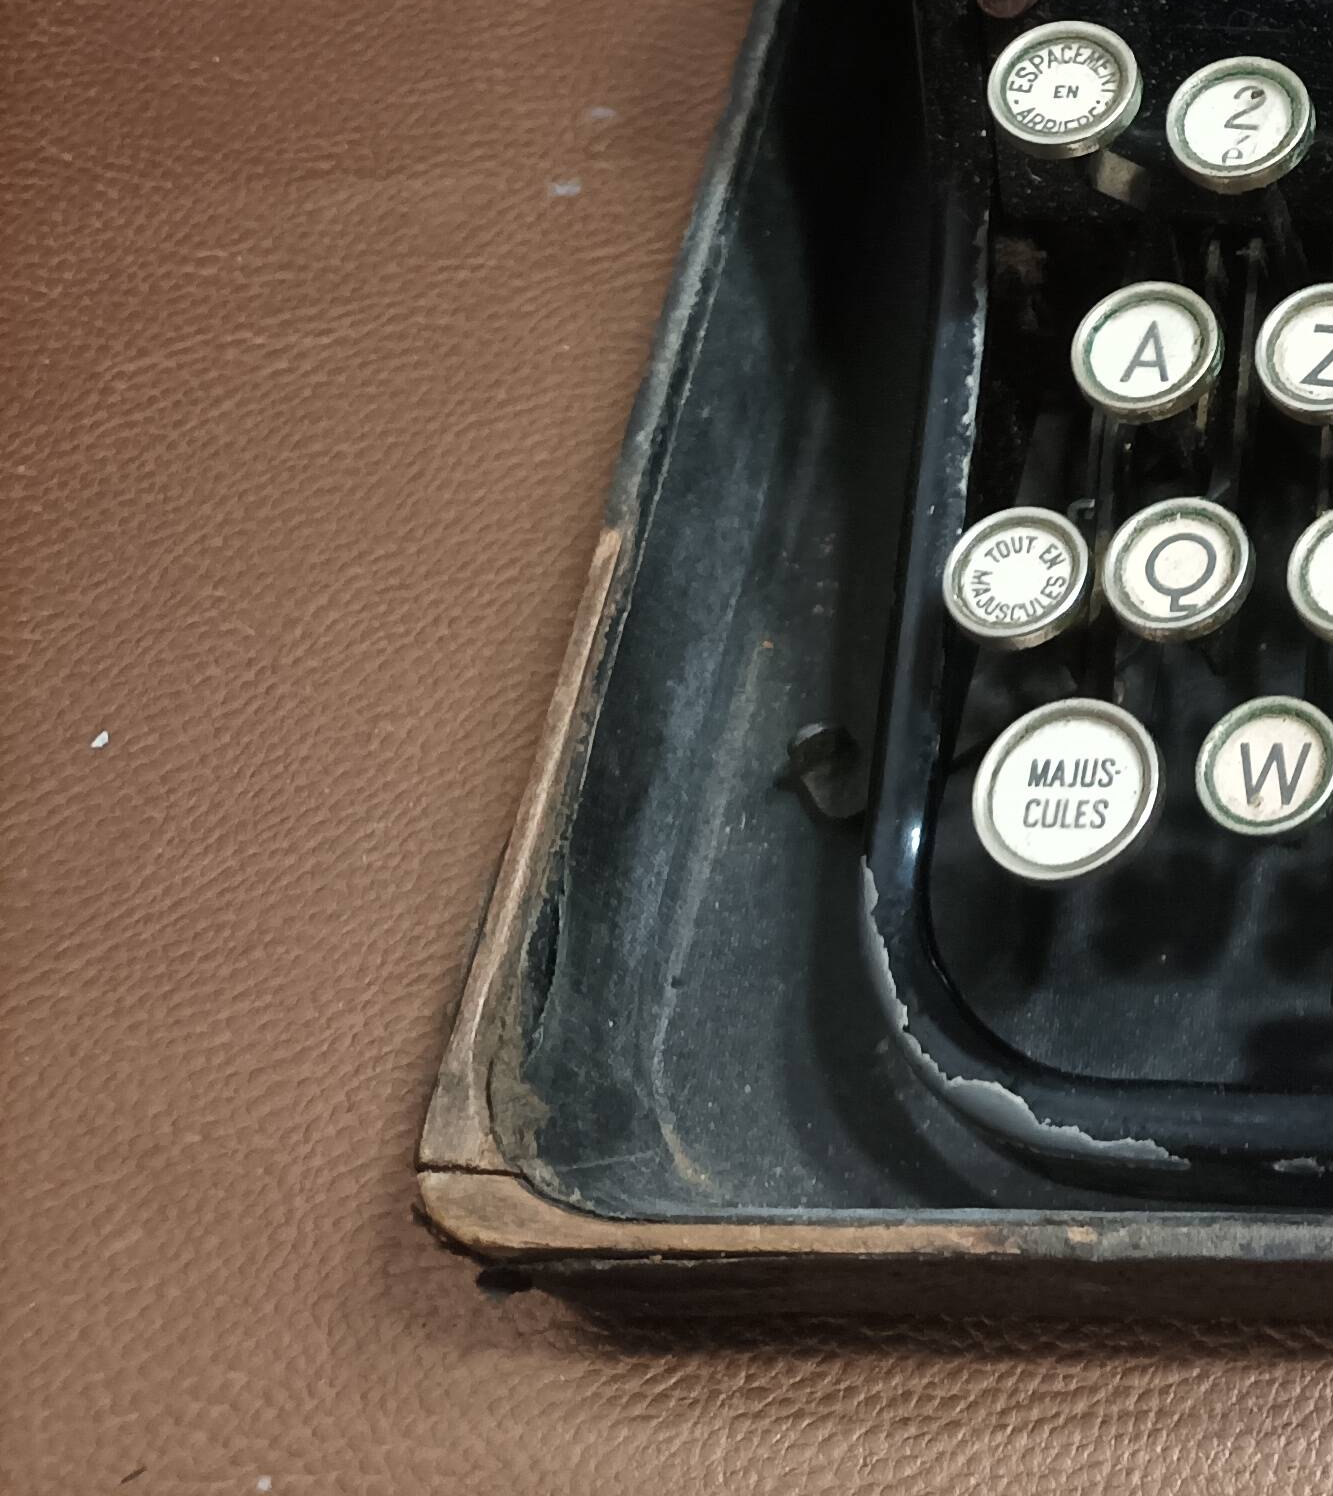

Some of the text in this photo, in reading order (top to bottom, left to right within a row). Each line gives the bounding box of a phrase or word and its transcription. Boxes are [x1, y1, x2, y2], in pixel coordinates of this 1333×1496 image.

[1053, 85, 1079, 99] EN
[1224, 84, 1266, 131] 2
[1119, 320, 1170, 383] A
[984, 535, 1067, 571] TOUT EN
[1144, 532, 1218, 613] Q
[1240, 741, 1312, 807] W
[1023, 798, 1110, 829] CULES
